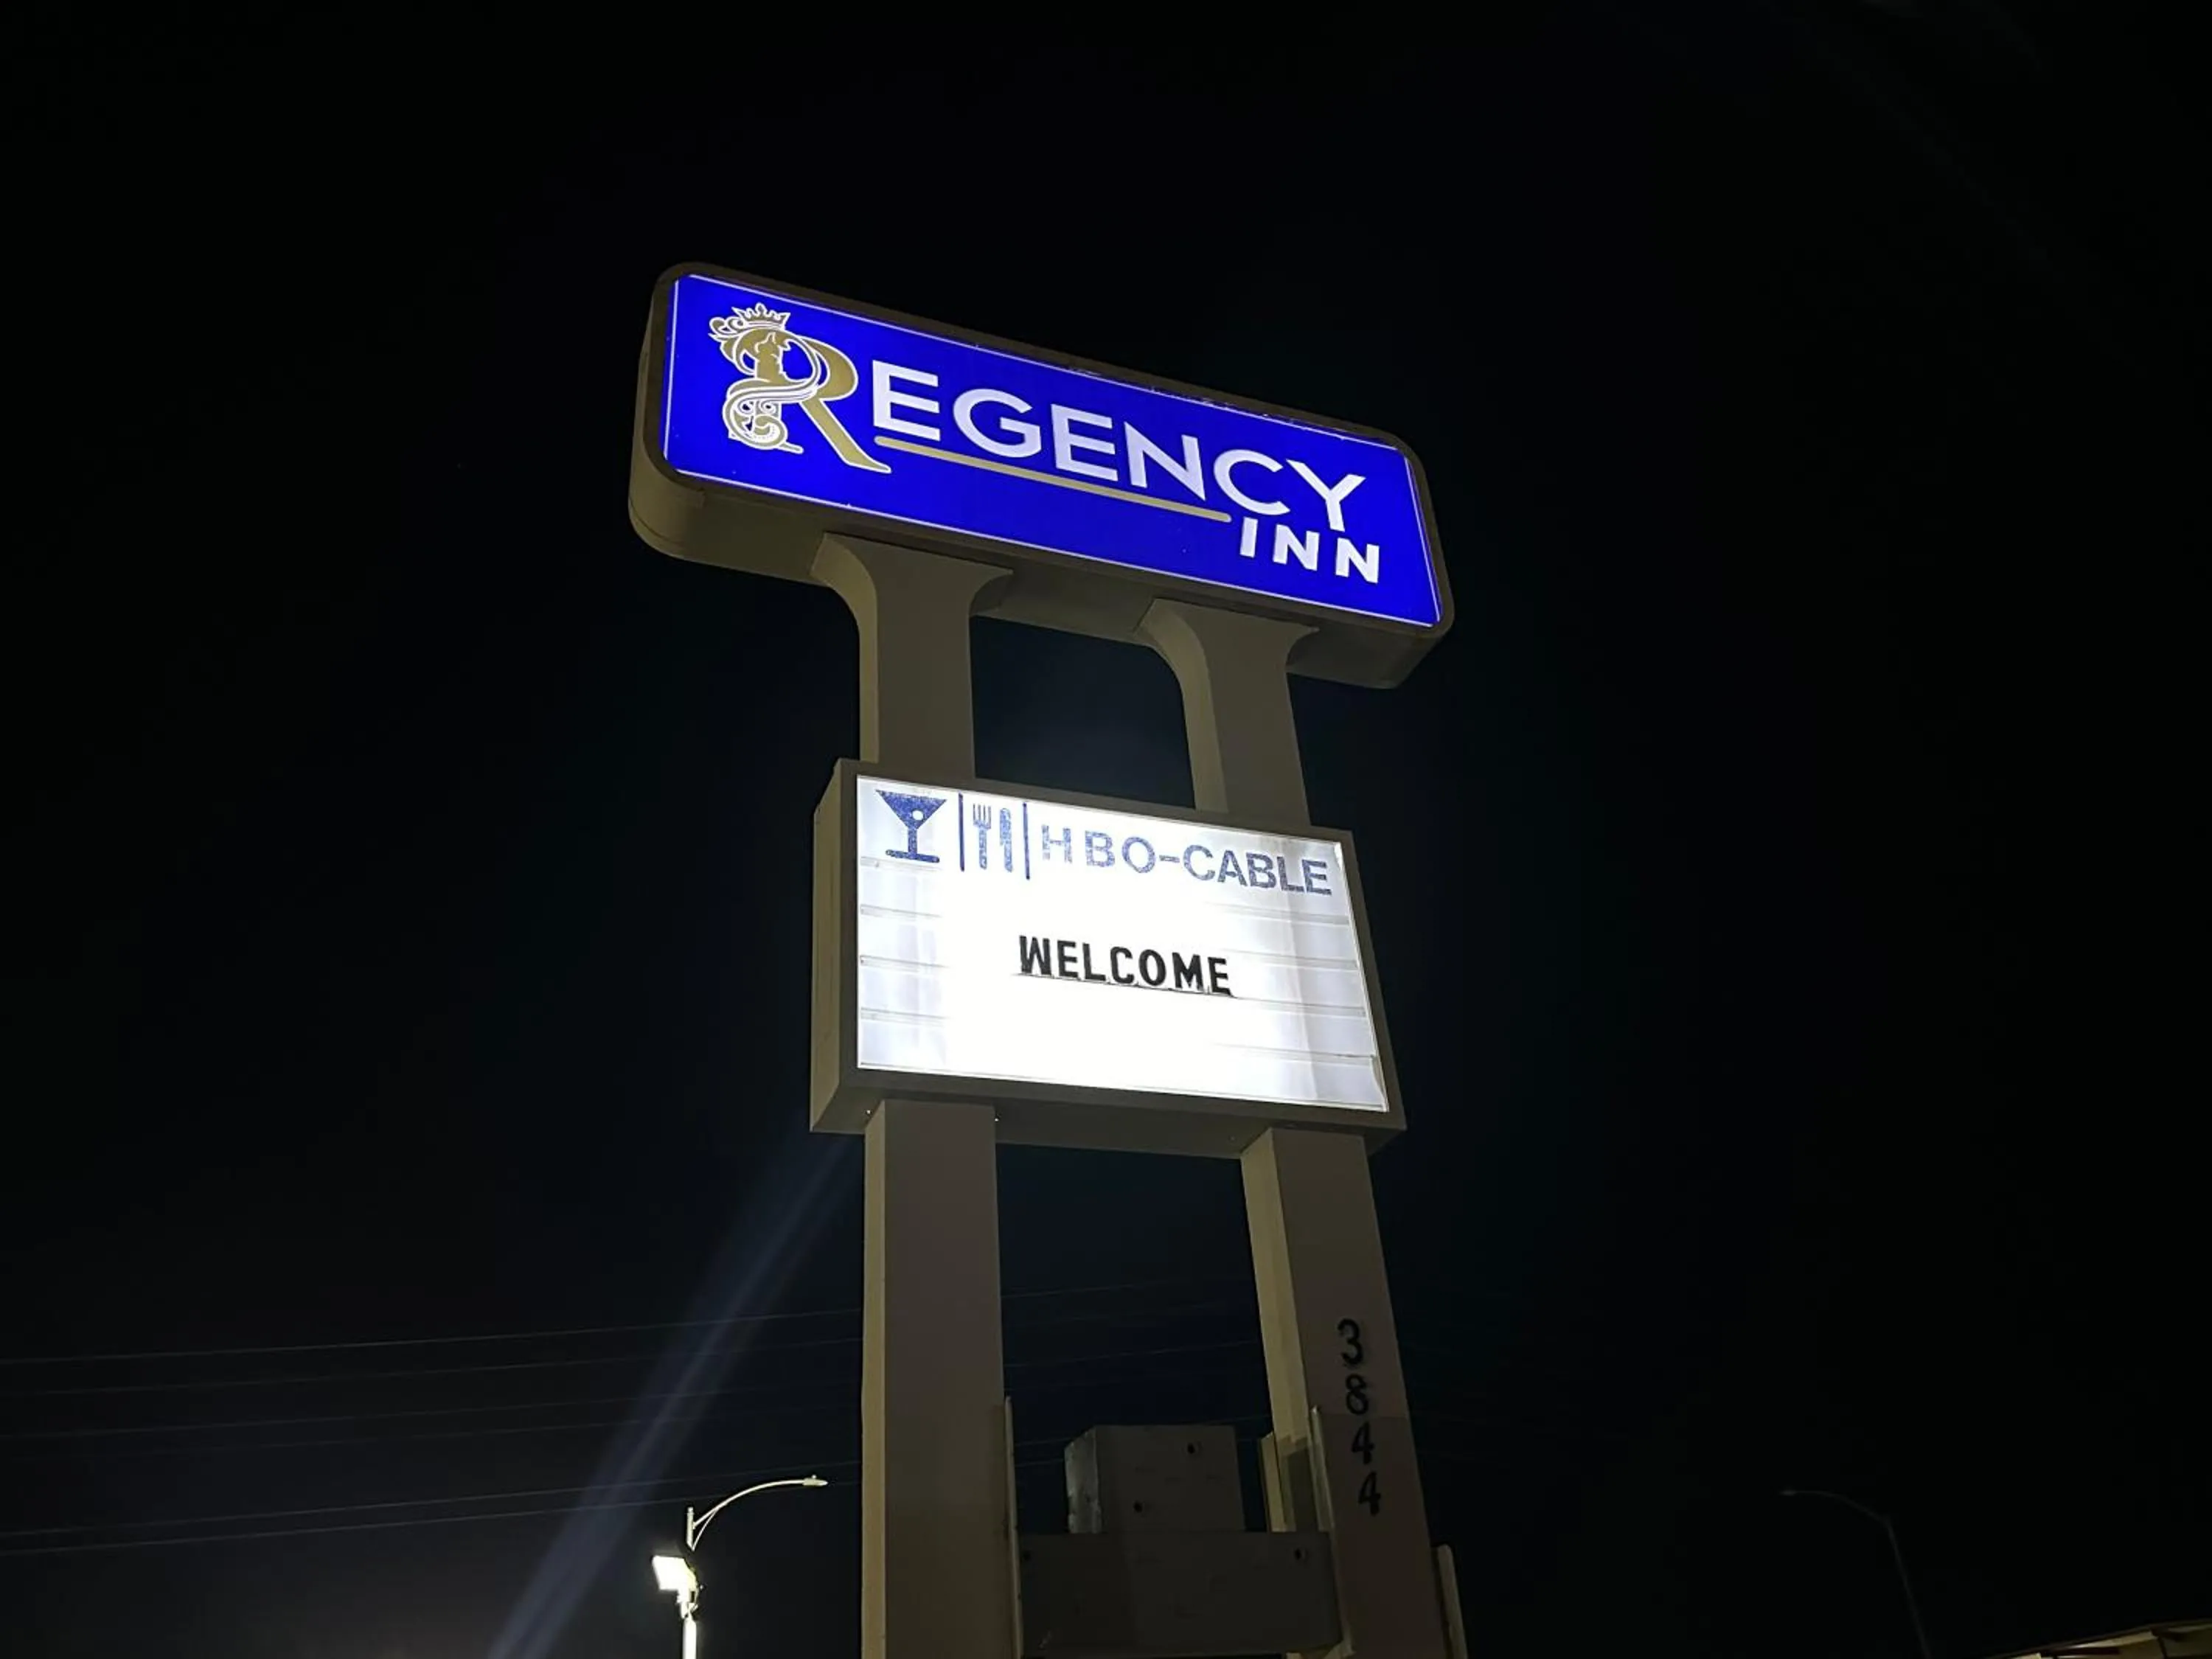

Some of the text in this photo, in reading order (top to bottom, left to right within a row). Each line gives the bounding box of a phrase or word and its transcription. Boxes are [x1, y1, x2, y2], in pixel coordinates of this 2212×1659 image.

[709, 304, 1366, 532] REGENCY
[1239, 516, 1380, 584] INN
[1041, 824, 1332, 896] HBO-CABLE
[1019, 934, 1233, 996] WELCOME
[1338, 1318, 1380, 1515] 3844
